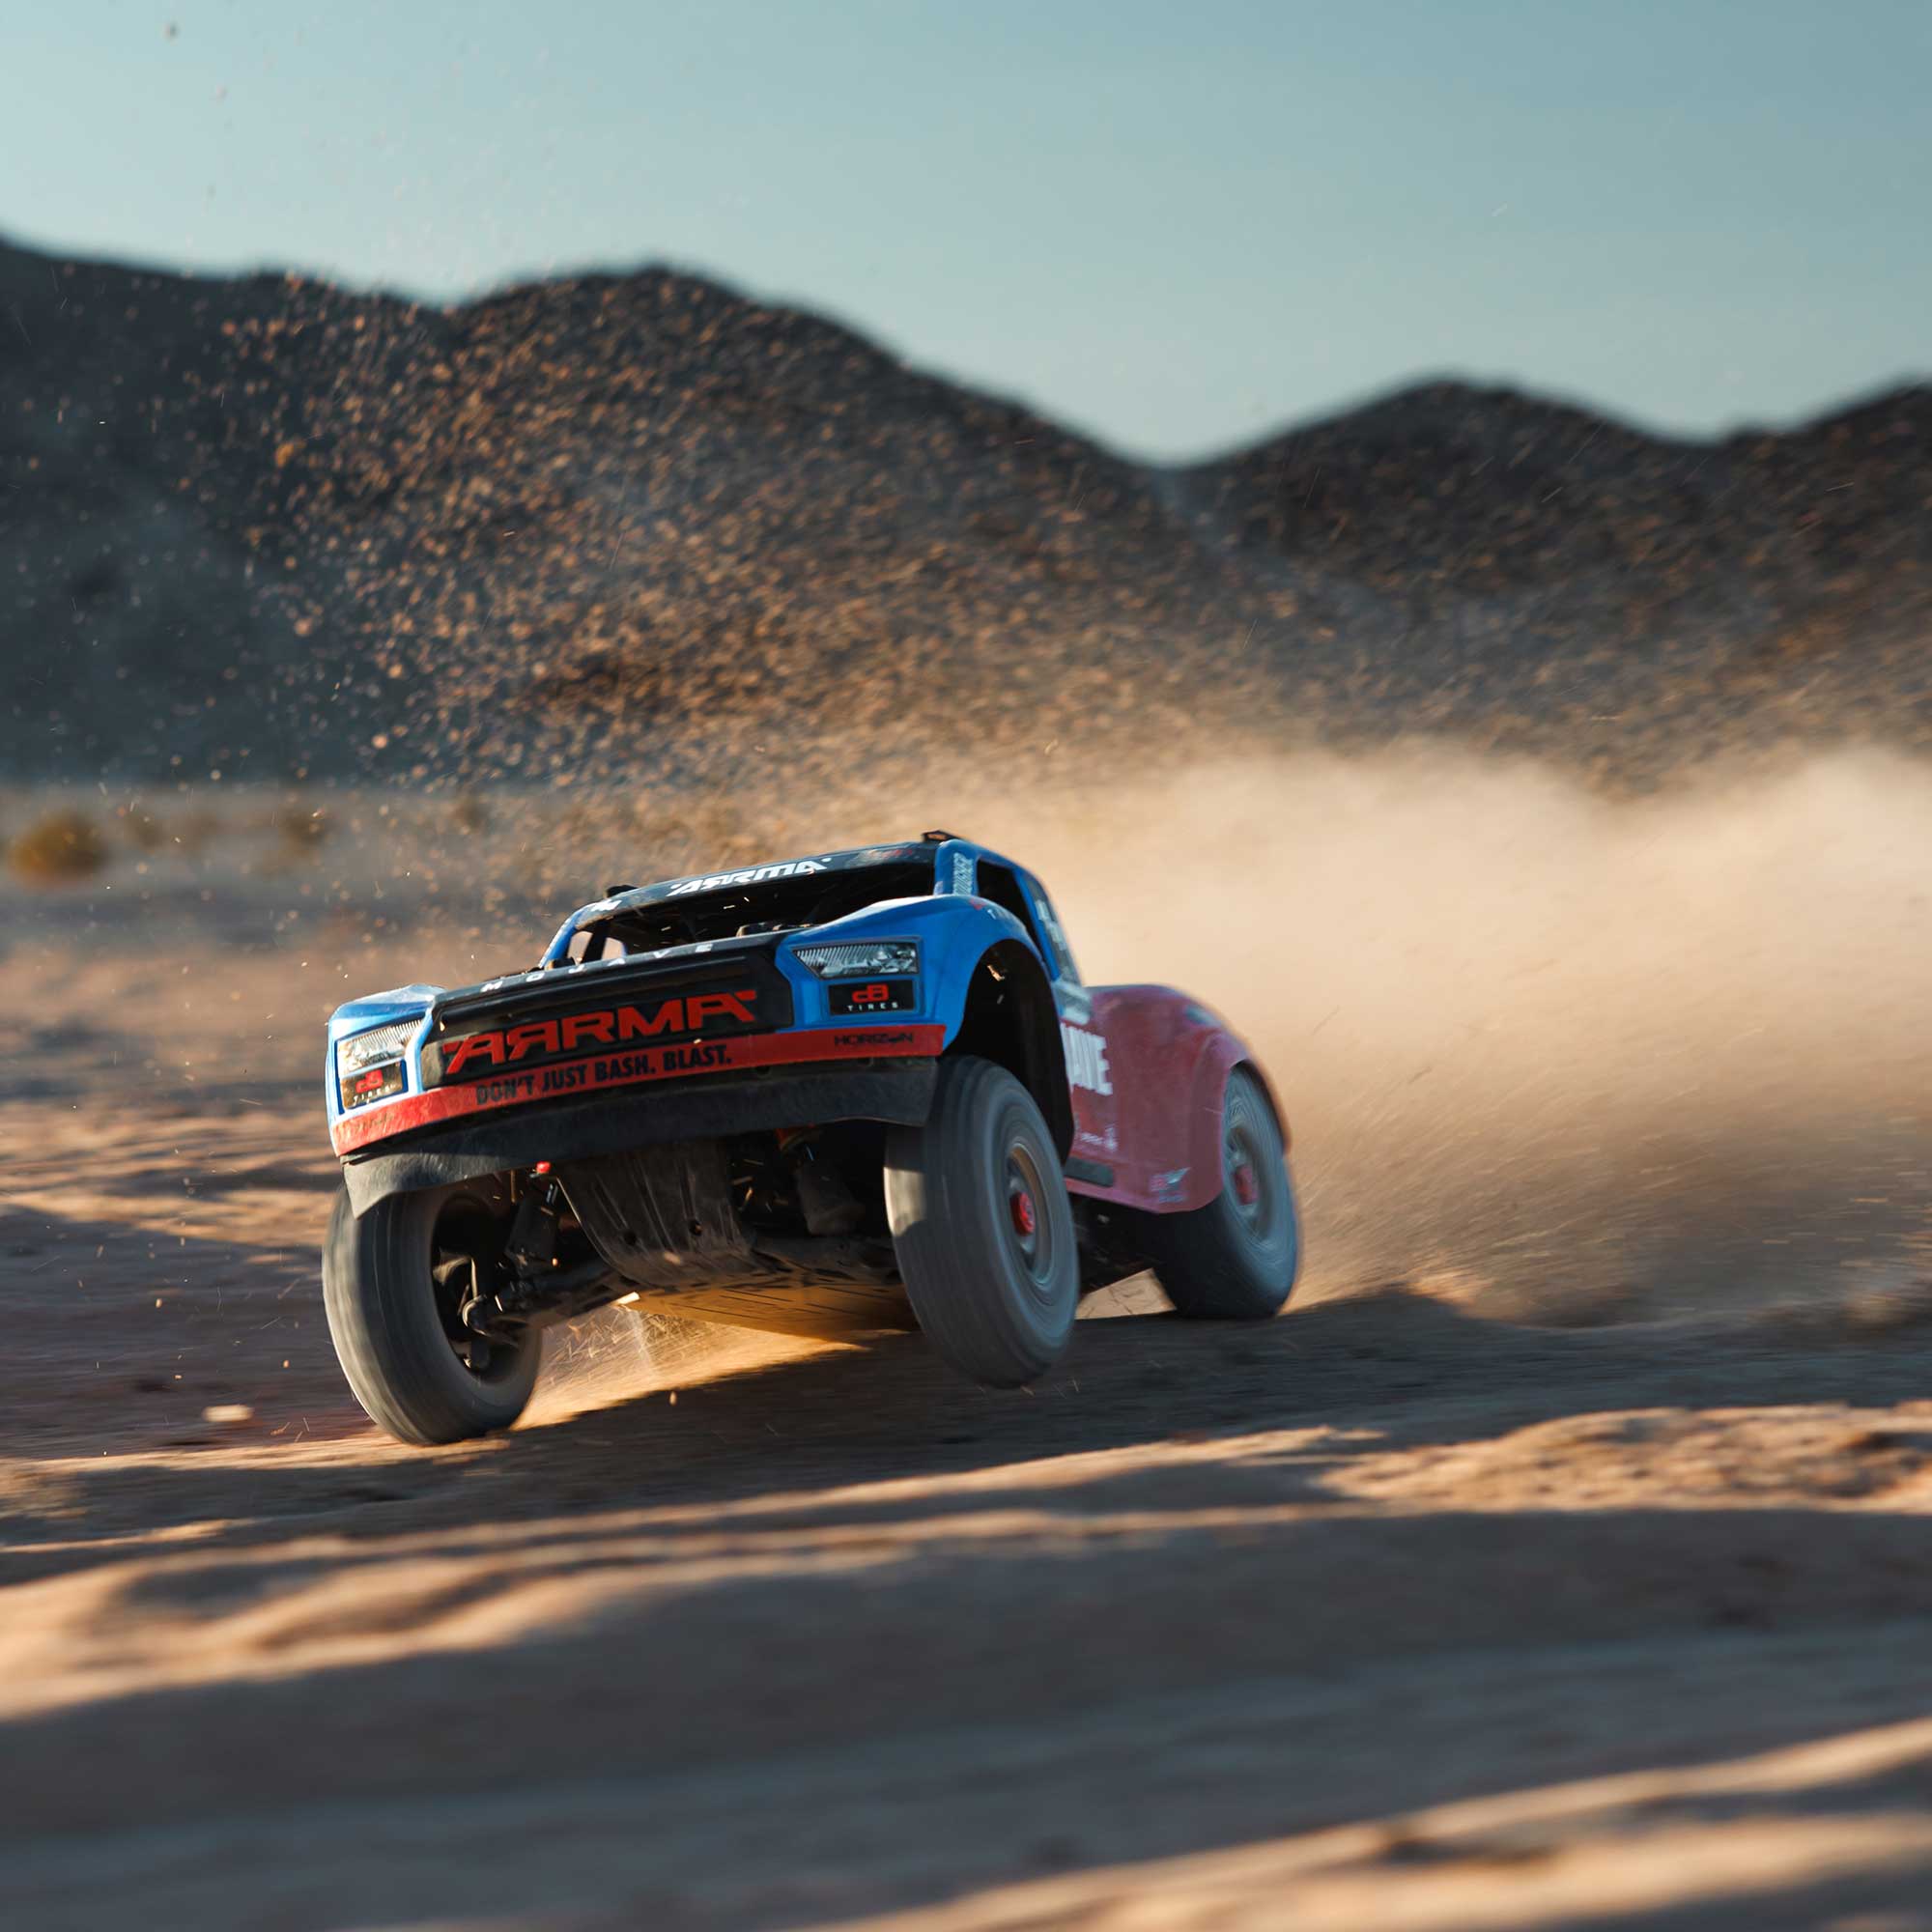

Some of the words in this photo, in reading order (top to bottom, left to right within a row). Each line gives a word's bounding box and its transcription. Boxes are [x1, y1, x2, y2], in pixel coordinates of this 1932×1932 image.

[480, 943, 714, 993] MOJAVE
[846, 1002, 899, 1012] TIRES
[476, 1074, 535, 1106] DON'T
[541, 1065, 590, 1094] JUST
[595, 1055, 657, 1083] BASH.
[663, 1044, 732, 1071] BLAST.
